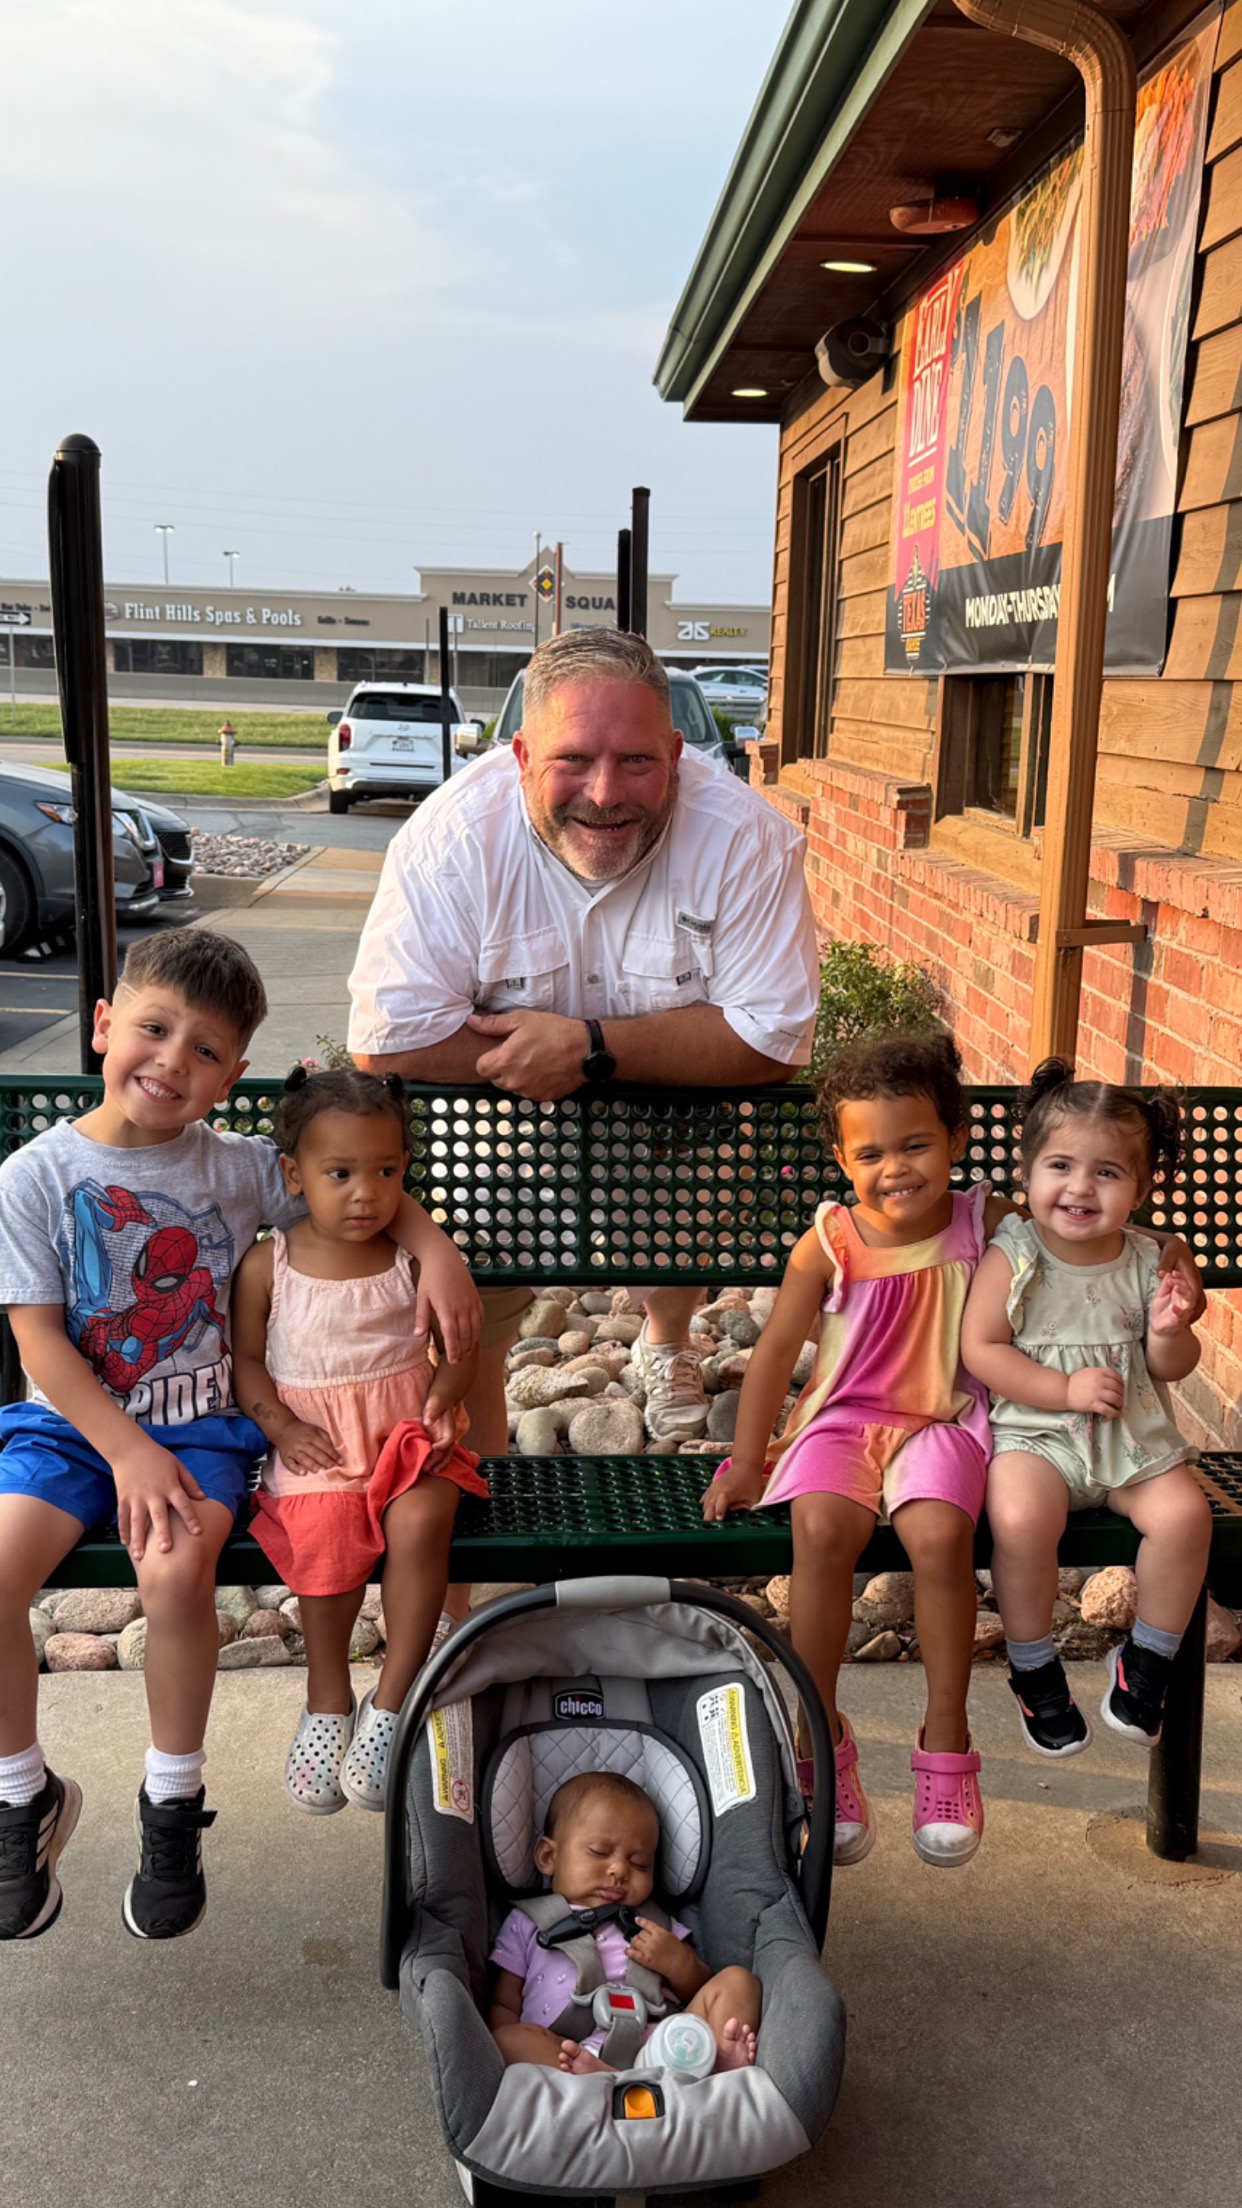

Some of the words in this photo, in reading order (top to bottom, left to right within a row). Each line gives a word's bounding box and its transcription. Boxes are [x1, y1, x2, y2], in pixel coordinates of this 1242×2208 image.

[913, 267, 961, 381] EARLY
[908, 359, 945, 458] DINE
[452, 591, 528, 607] MARKET
[565, 595, 616, 610] SQUA
[902, 589, 926, 634] TEXAS
[125, 602, 161, 620] Flint
[165, 604, 201, 622] Hills
[205, 606, 242, 626] Spas
[246, 607, 257, 625] &
[262, 608, 302, 626] Pools
[501, 620, 537, 633] Roofing
[710, 627, 747, 637] REALTY
[560, 1696, 603, 1716] chicco
